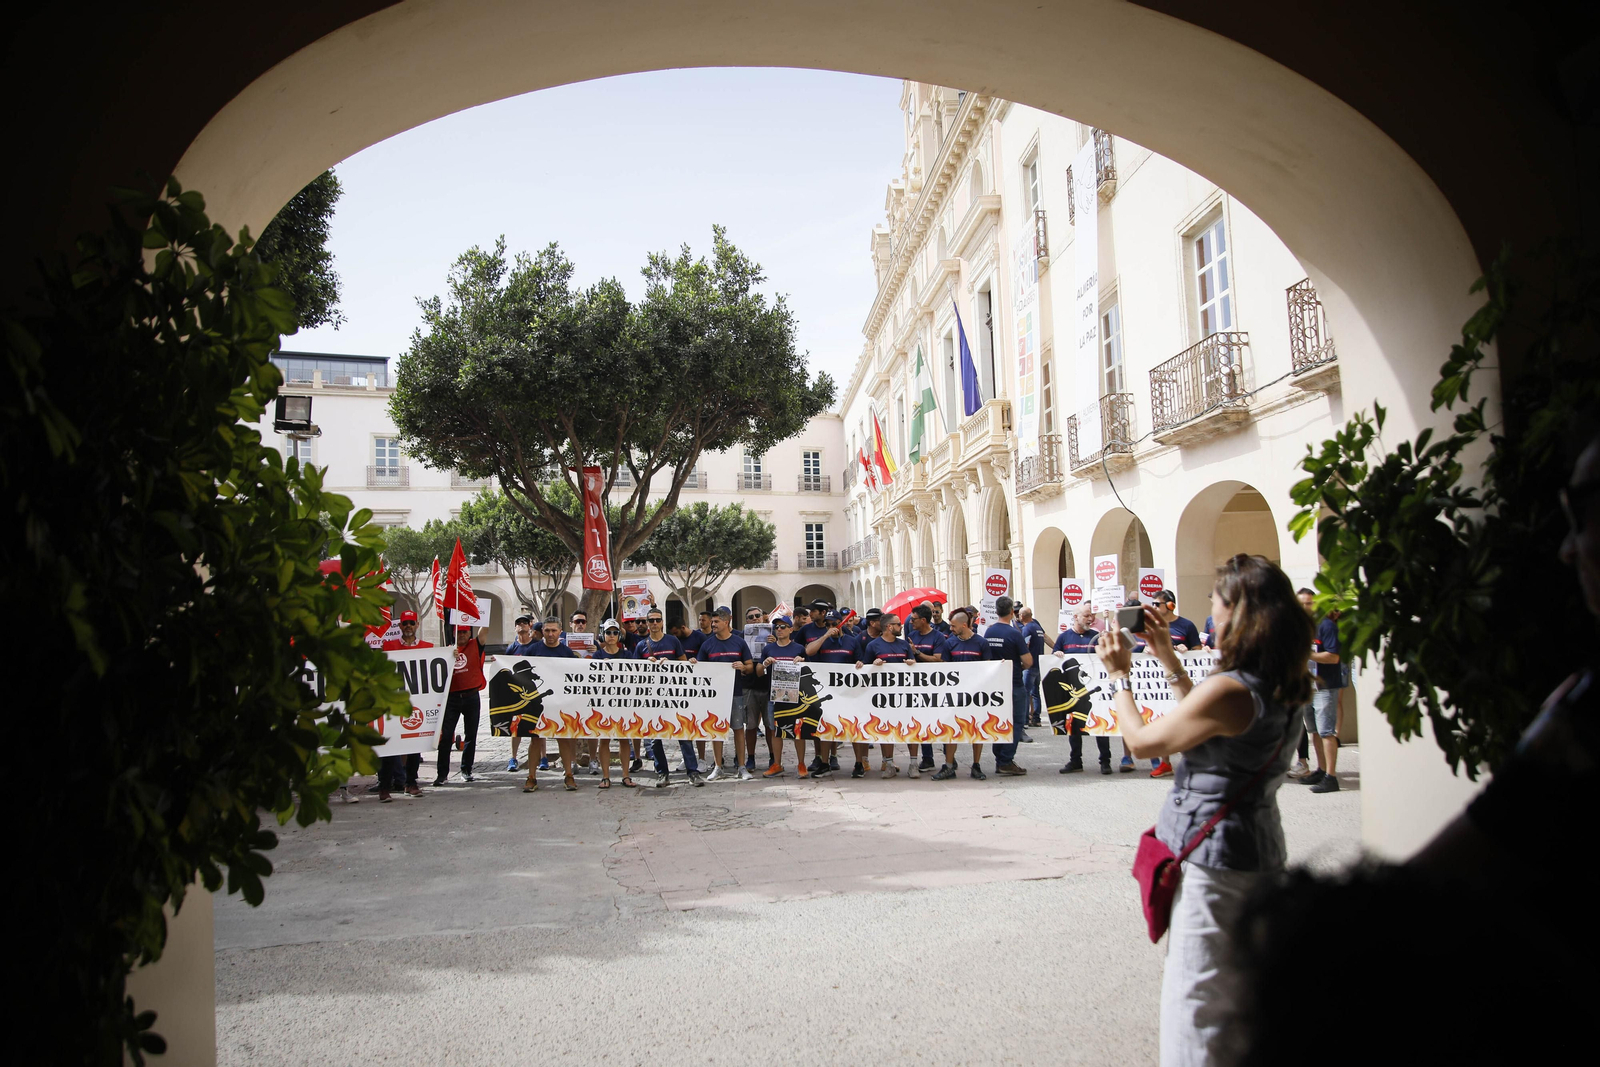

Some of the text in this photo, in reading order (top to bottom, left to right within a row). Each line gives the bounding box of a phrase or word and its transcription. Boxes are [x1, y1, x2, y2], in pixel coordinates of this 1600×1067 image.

[1082, 302, 1094, 321] POR
[1079, 325, 1097, 349] LA PAZ
[589, 661, 695, 674] SIN INVERSIÓN
[564, 673, 712, 687] NO SE PUEDE DAR UN
[828, 670, 960, 688] BOMBEROS
[1137, 681, 1152, 690] LA
[563, 685, 717, 698] SERVICIO DE CALIDAD
[587, 697, 690, 709] AL CIUDADANO
[871, 690, 1005, 709] QUEMADOS
